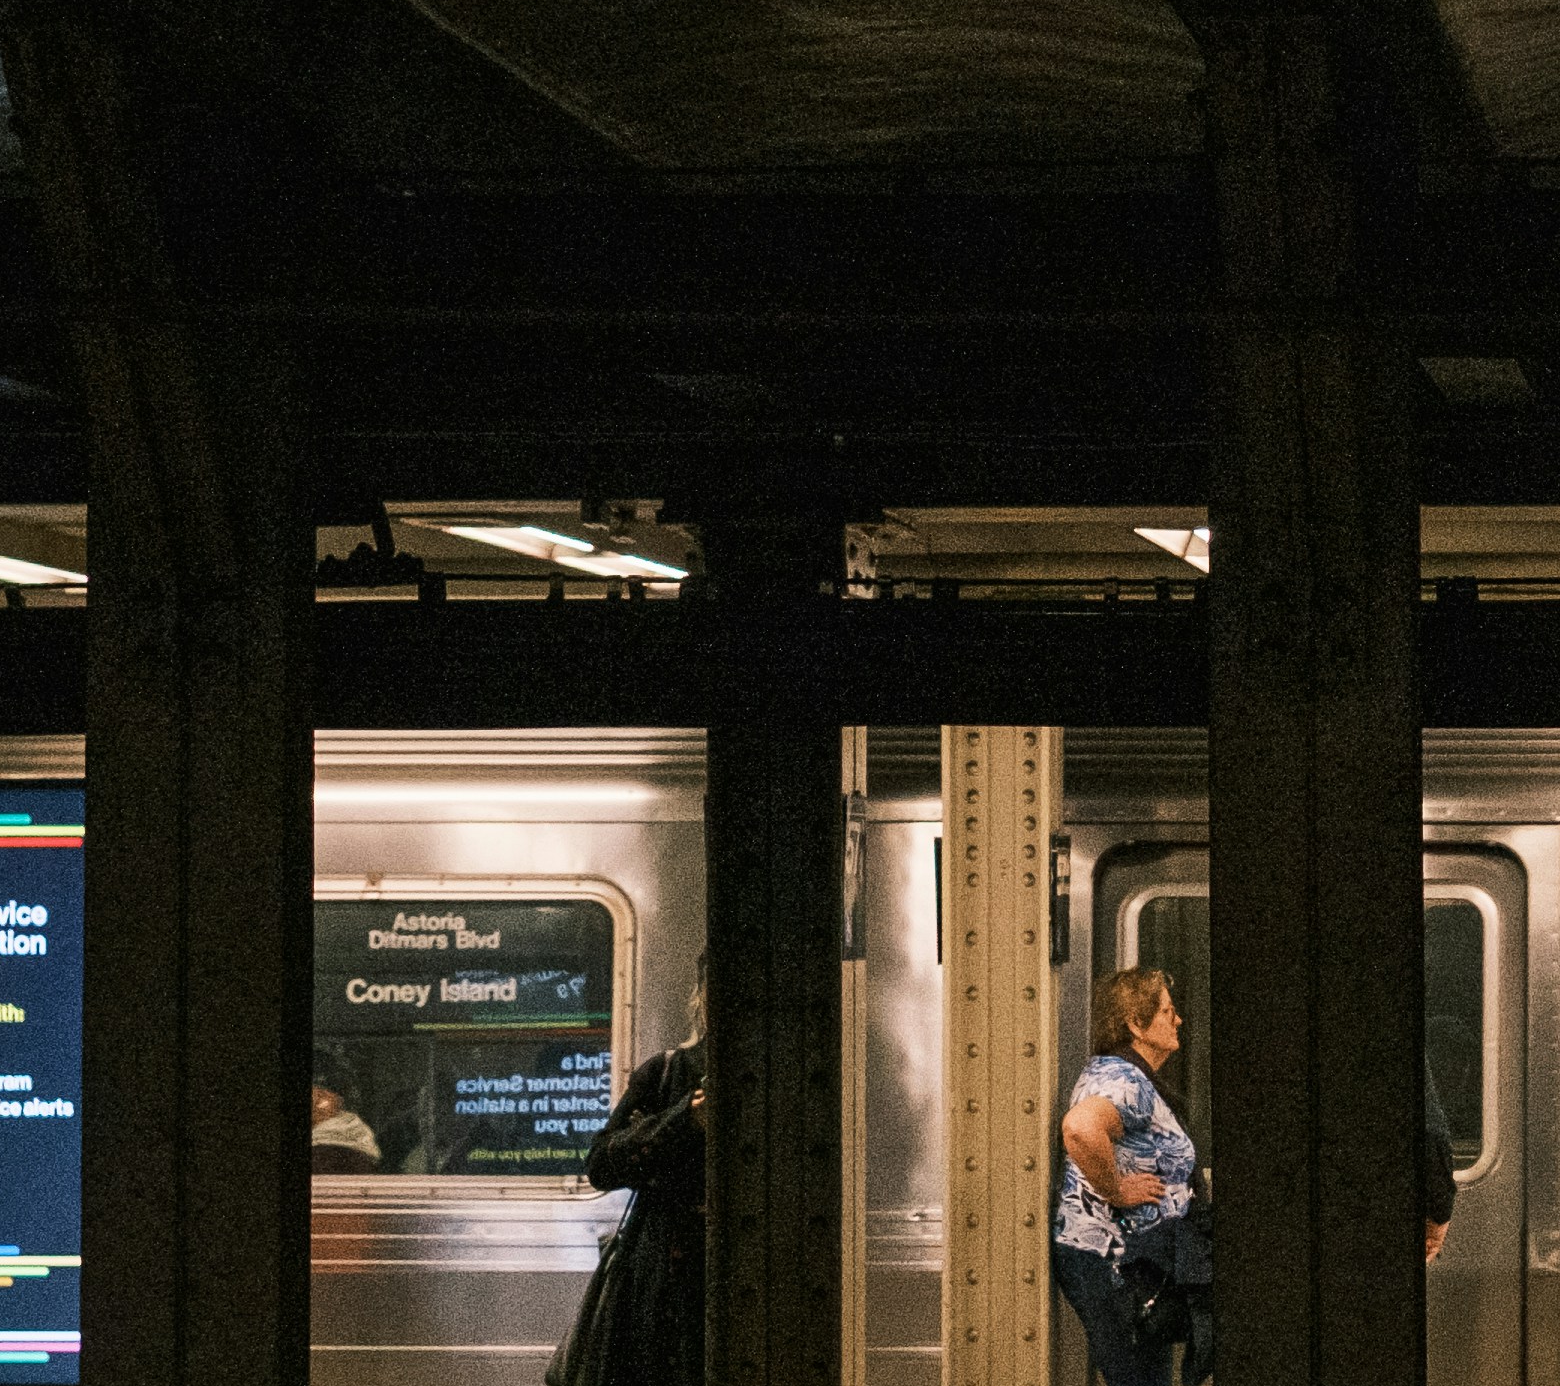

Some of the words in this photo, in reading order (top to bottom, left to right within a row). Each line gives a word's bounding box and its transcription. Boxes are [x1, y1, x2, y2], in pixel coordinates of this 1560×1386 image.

[394, 913, 466, 930] Astoria
[369, 930, 448, 949] Ditmars
[455, 930, 501, 949] Blvd
[346, 978, 431, 1008] Coney
[440, 977, 517, 1002] Island
[23, 1097, 74, 1117] alerts
